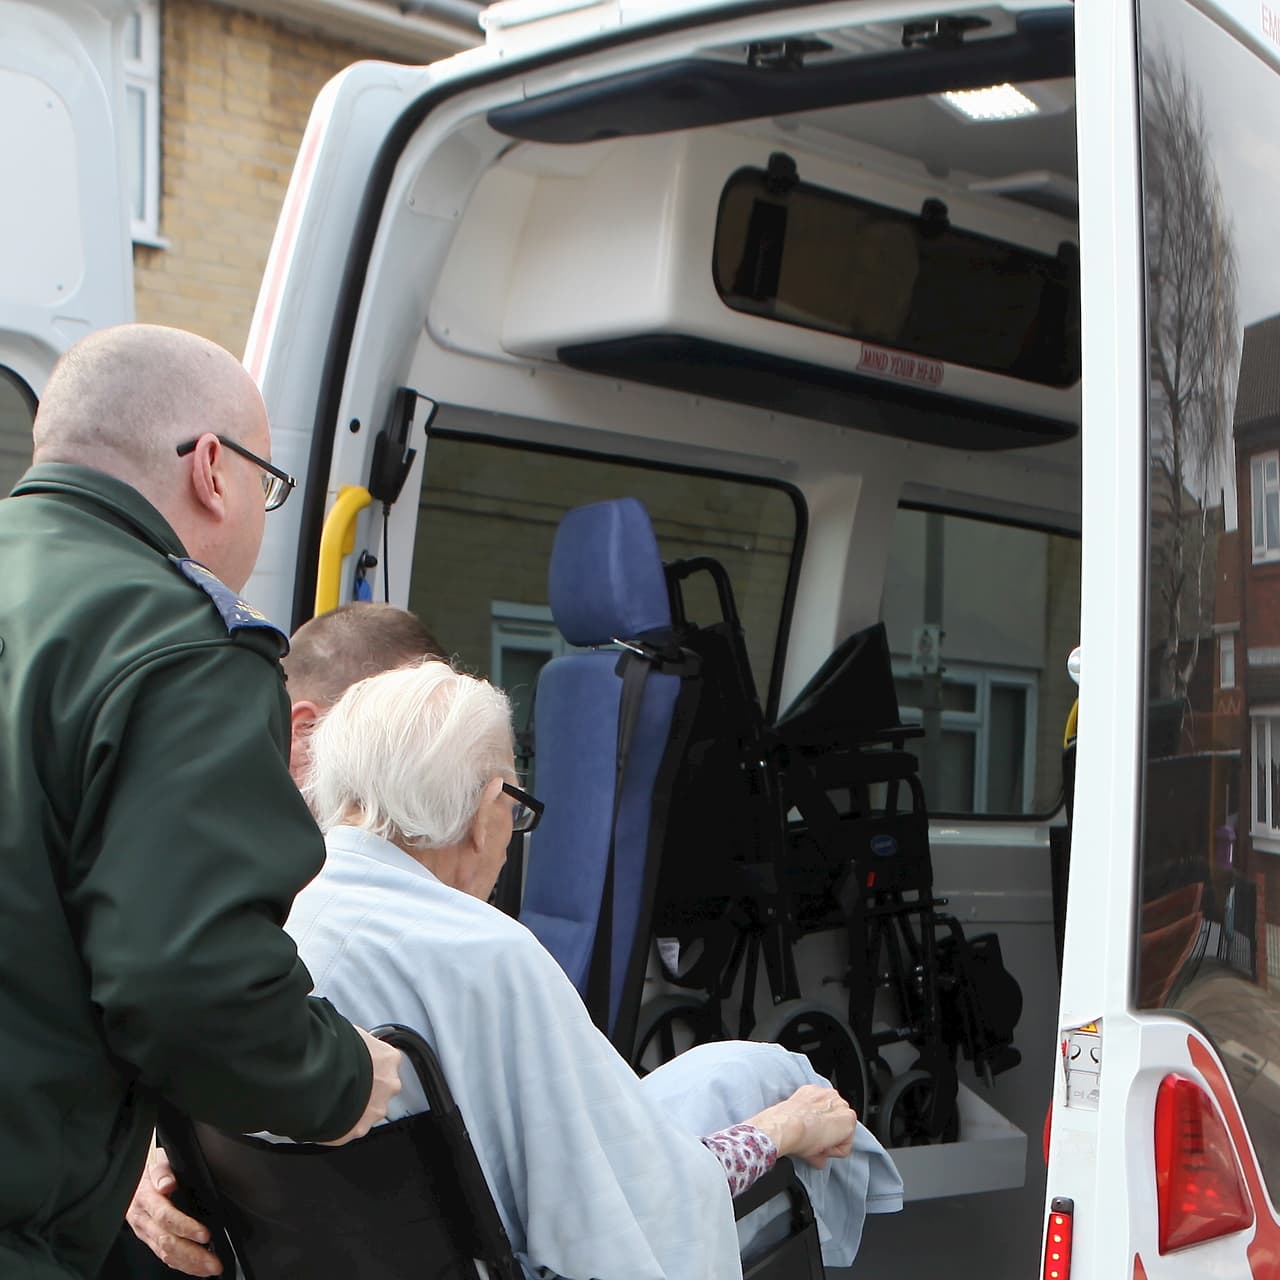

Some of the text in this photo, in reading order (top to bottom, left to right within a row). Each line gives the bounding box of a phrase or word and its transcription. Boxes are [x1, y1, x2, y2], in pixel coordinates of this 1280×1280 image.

[863, 348, 944, 383] MIND YOUR HEAD
